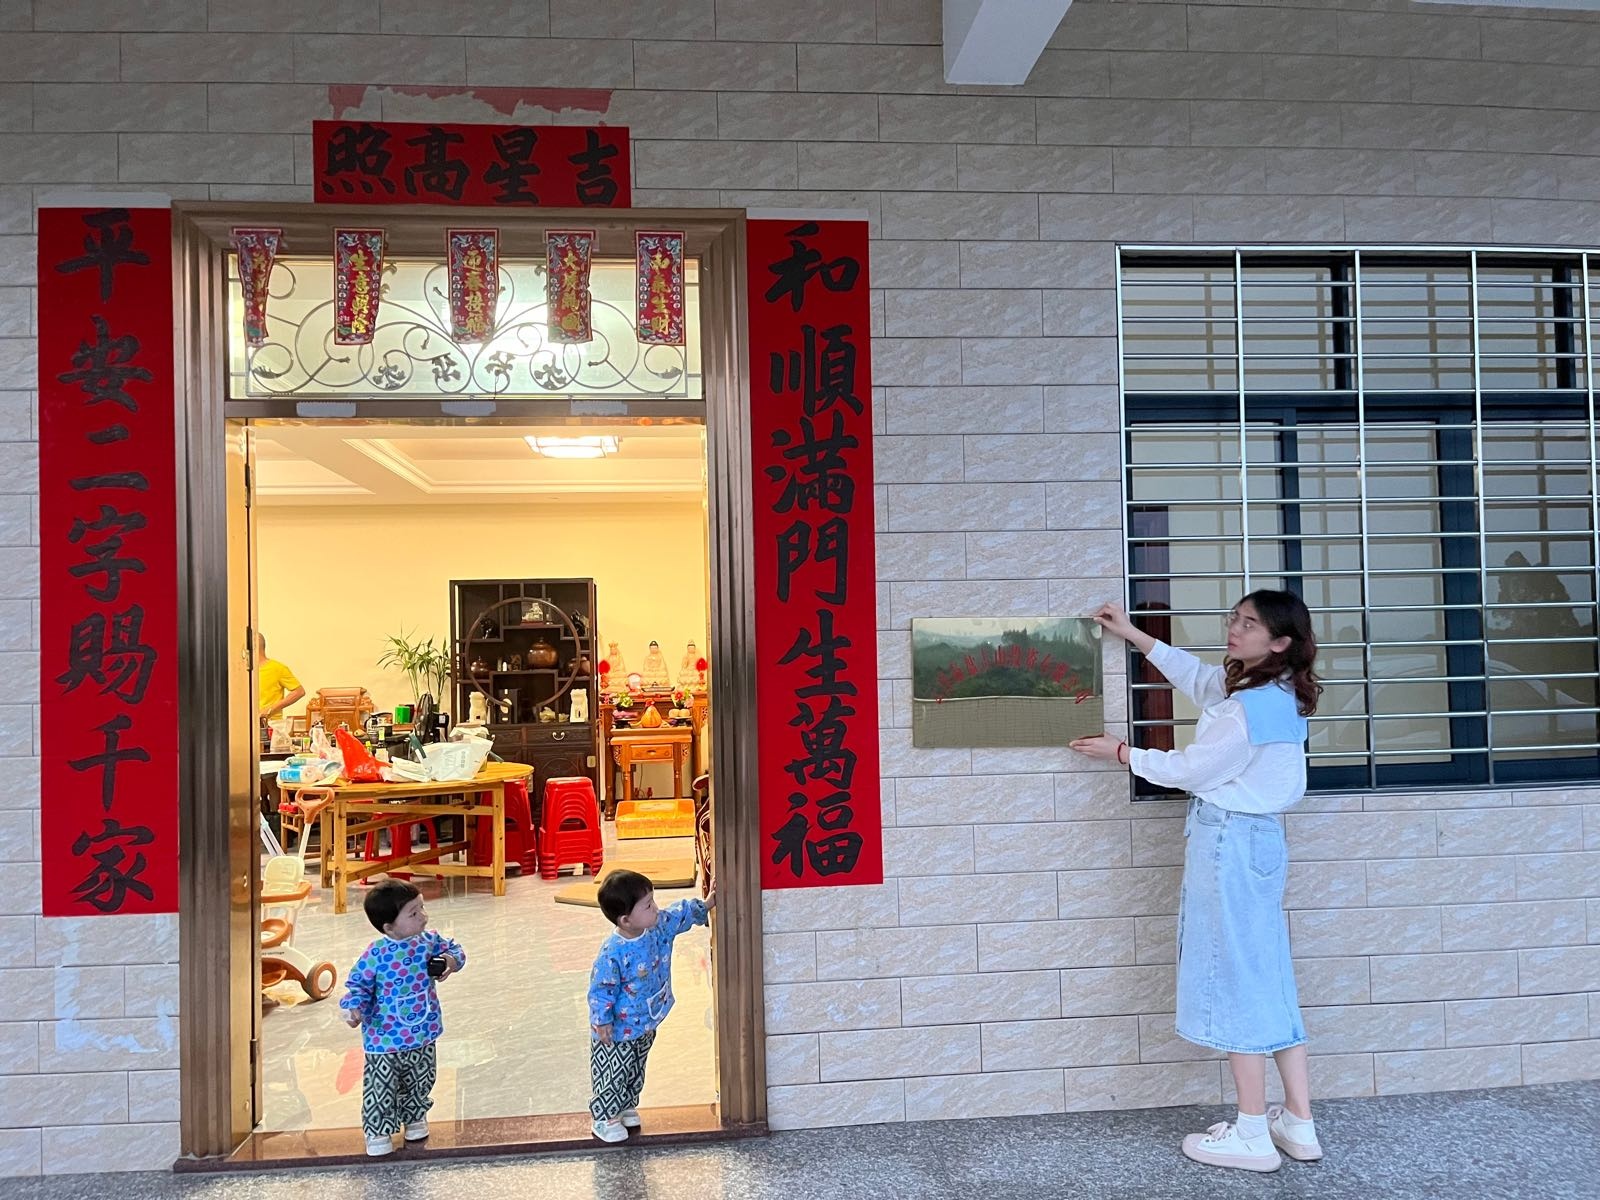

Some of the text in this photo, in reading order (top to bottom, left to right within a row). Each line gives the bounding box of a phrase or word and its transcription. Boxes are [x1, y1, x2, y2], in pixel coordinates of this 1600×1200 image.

[54, 207, 158, 913] 平安二字賜千家
